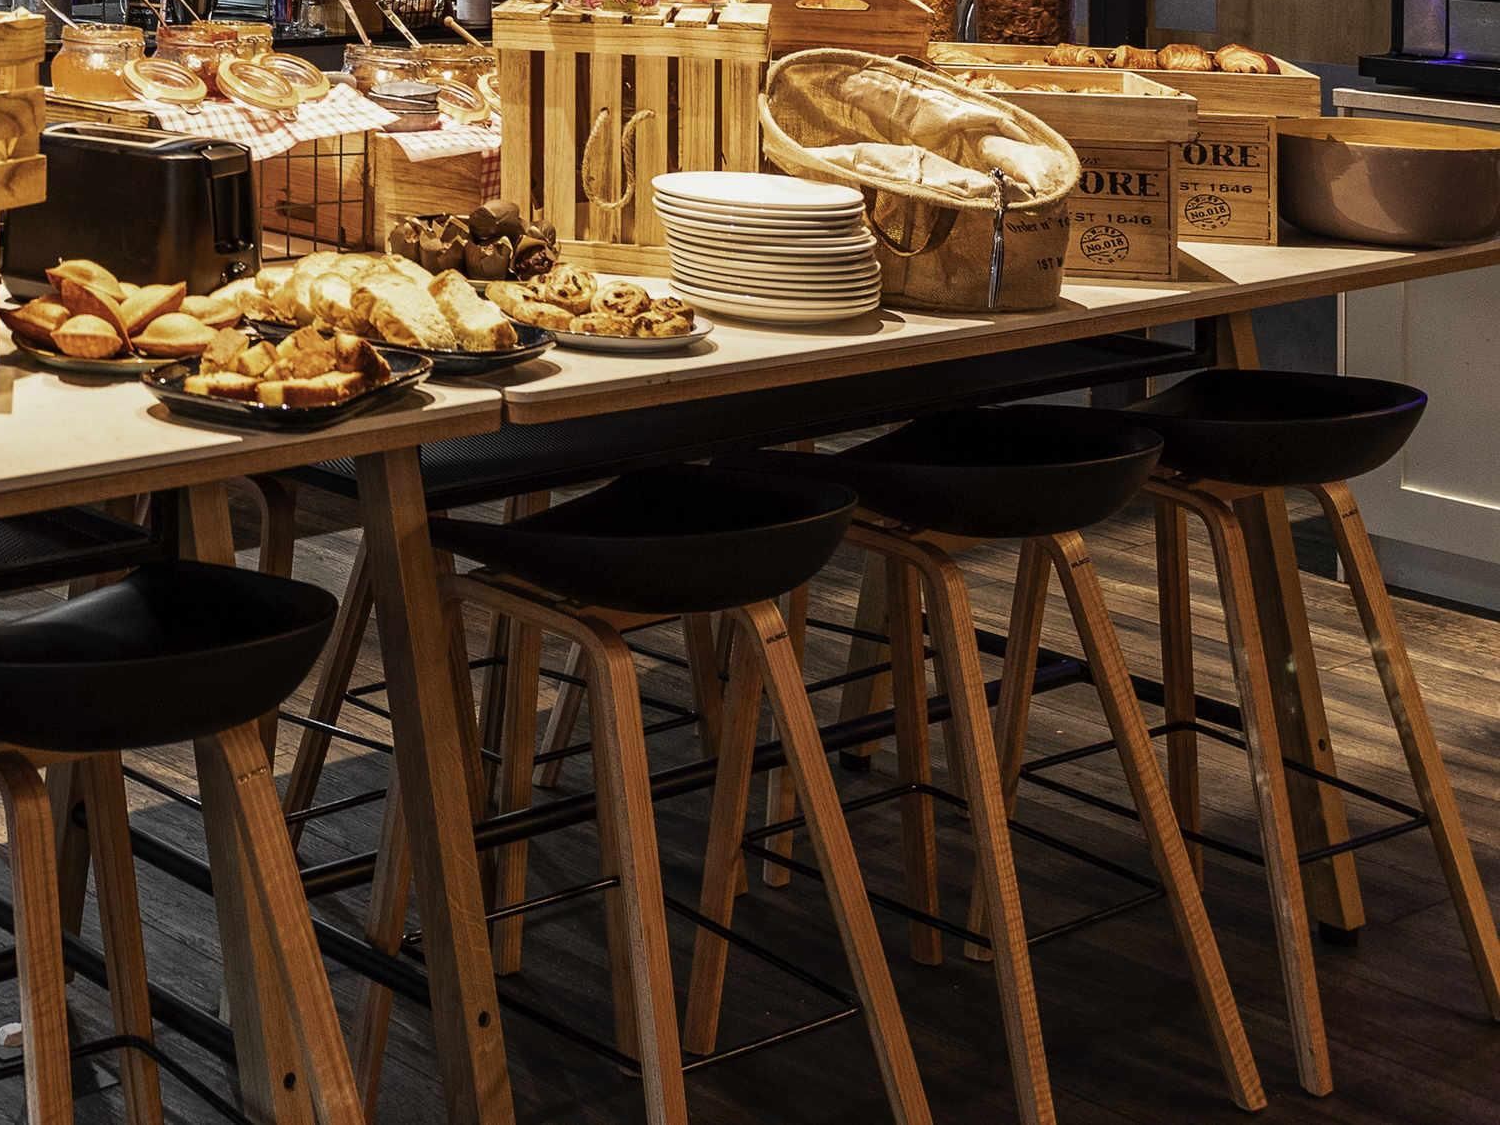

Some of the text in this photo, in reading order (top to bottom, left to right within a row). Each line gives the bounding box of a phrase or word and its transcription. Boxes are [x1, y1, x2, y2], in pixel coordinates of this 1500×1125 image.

[1182, 142, 1260, 168] ORE
[1079, 169, 1160, 197] ORE
[1179, 181, 1253, 194] ST 1846
[1069, 211, 1153, 226] ST 1846
[1189, 204, 1227, 221] No.018
[1086, 237, 1124, 254] No.018
